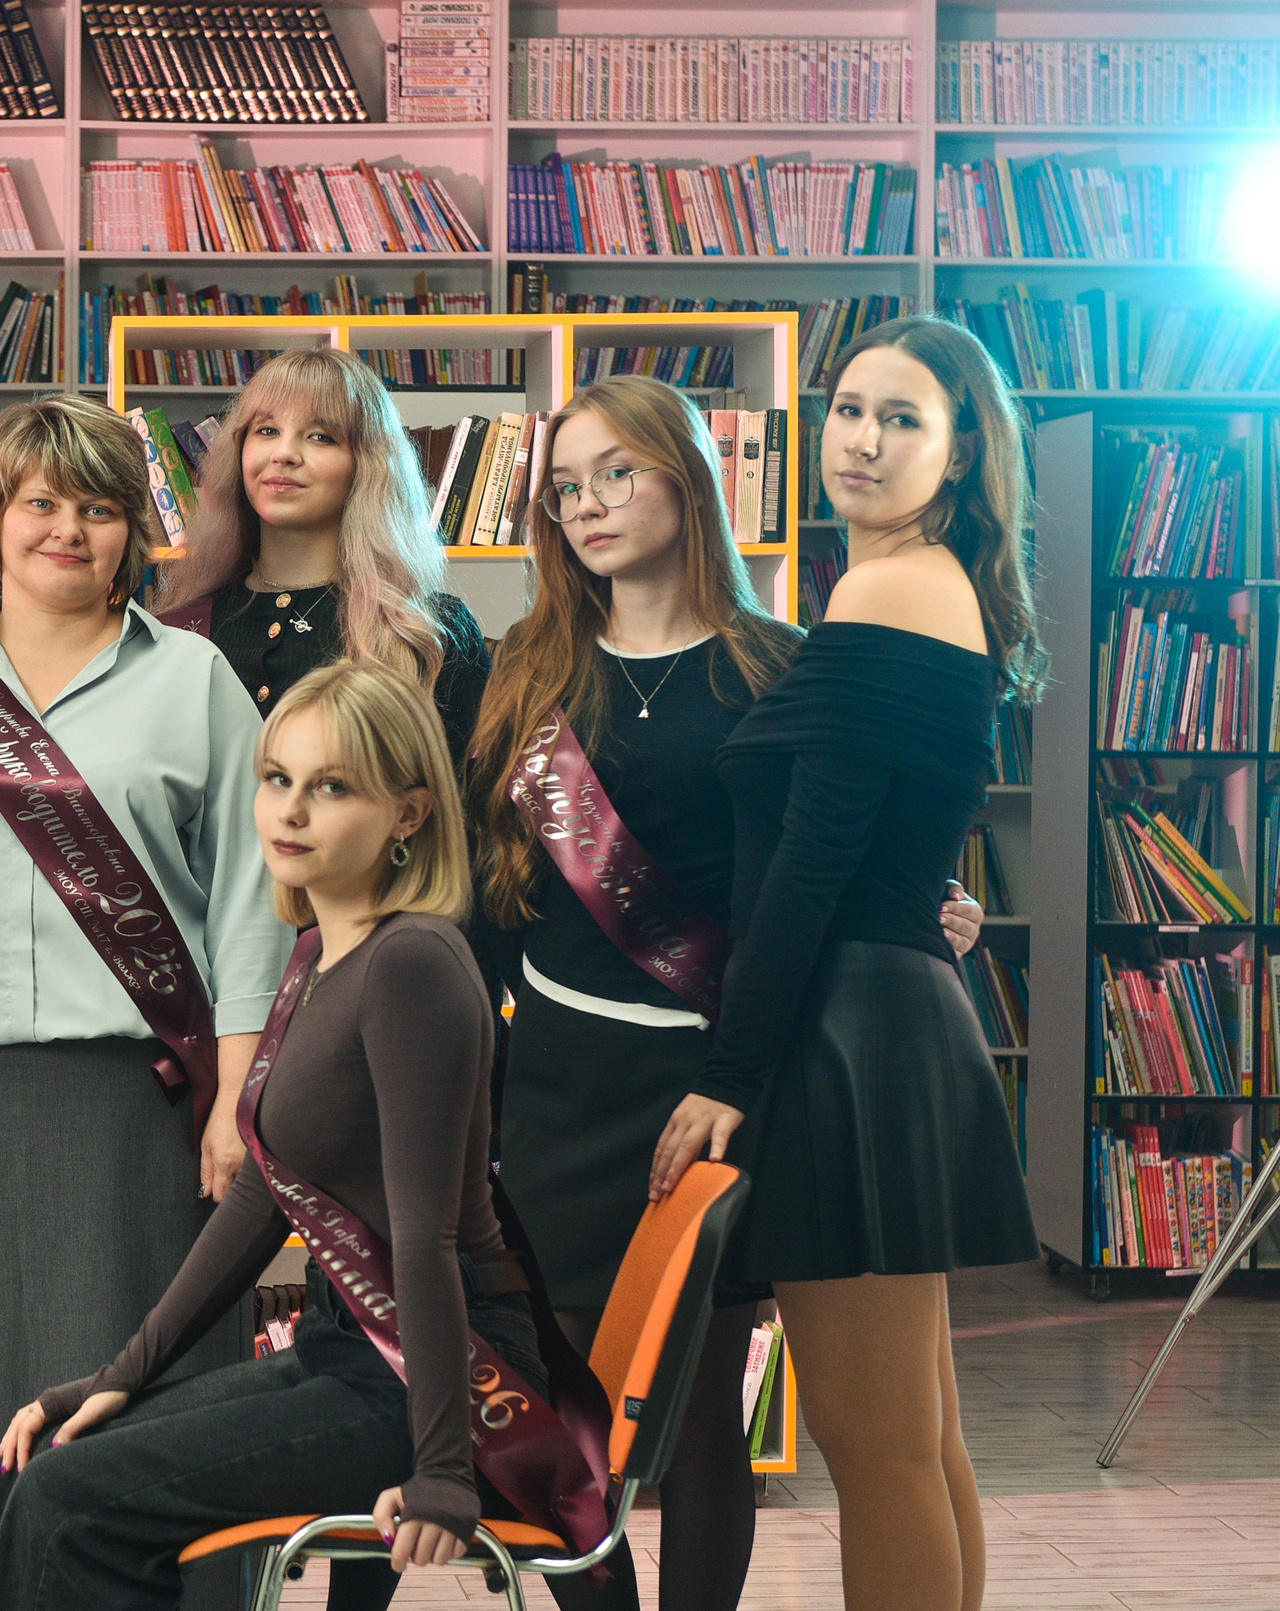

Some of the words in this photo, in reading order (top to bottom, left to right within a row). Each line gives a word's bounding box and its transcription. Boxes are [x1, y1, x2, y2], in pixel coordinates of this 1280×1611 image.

[490, 435, 508, 486] КАРАЧ-МУРЗА
[490, 483, 504, 522] БОГАТЫРИ
[499, 435, 515, 483] ПРОСНУЛИСЬ
[30, 739, 59, 777] Елена
[61, 781, 126, 874] Викторовна
[54, 869, 83, 896] МОУ
[74, 898, 97, 919] СШ
[91, 881, 182, 995] 2026
[649, 956, 678, 979] МОУ
[319, 1210, 373, 1260] Дарья
[751, 1341, 765, 1374] ЗАТМЕНИЕ
